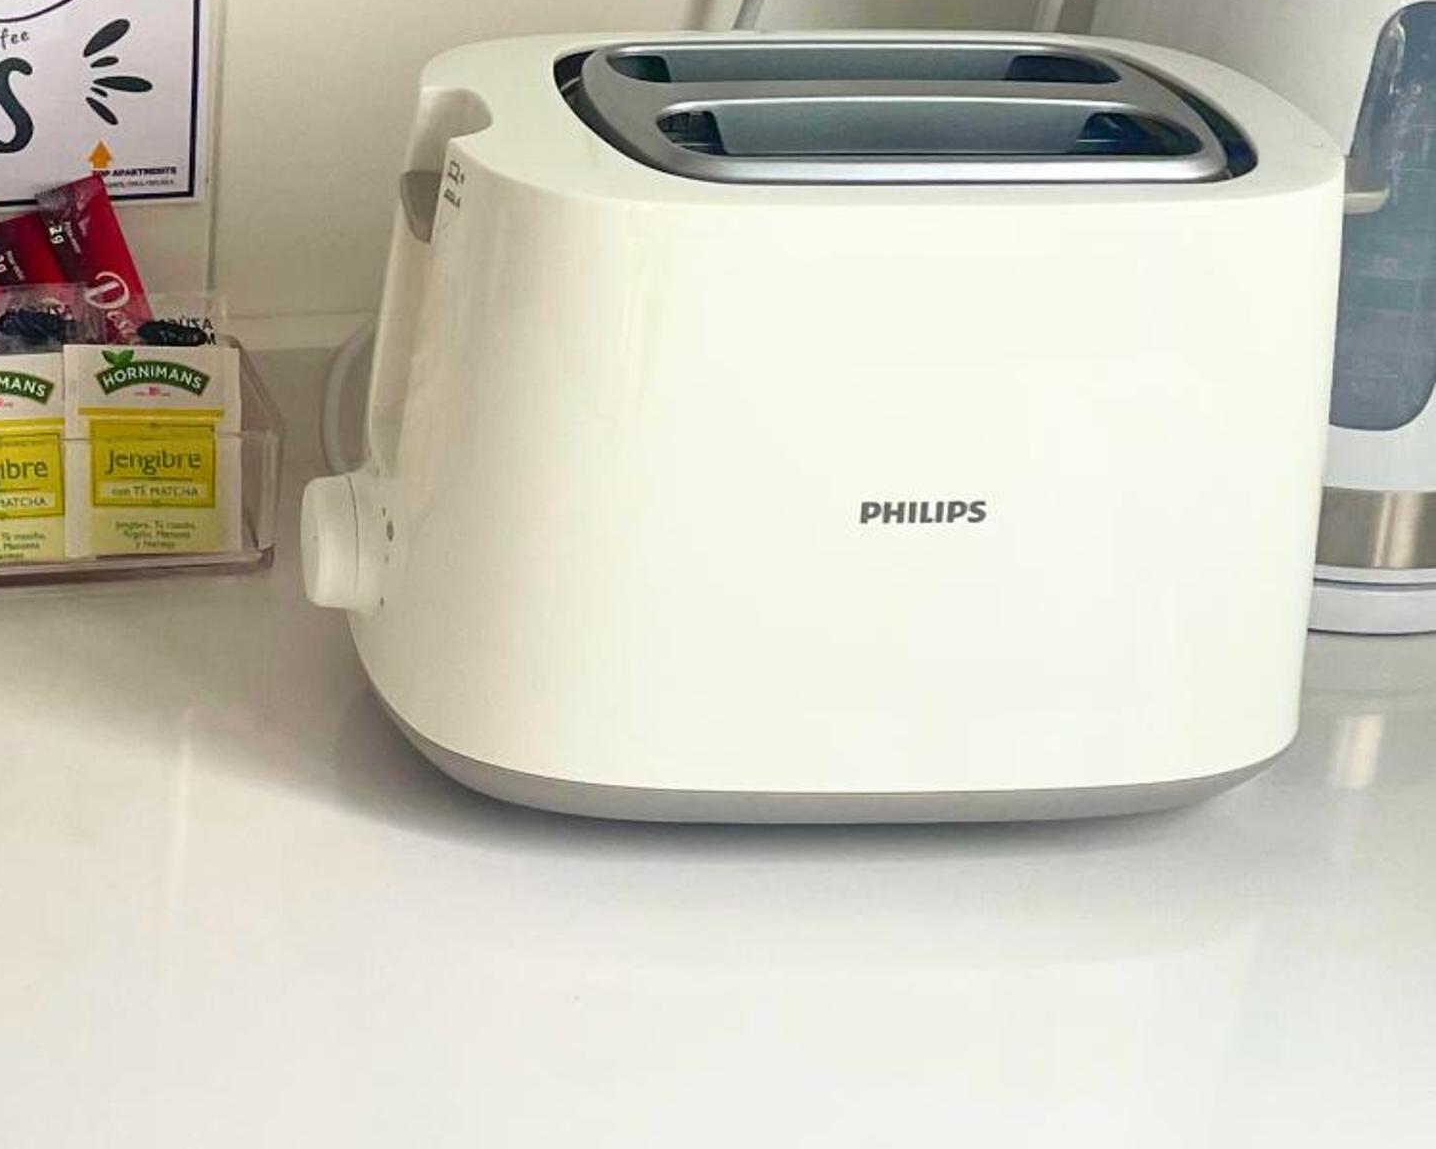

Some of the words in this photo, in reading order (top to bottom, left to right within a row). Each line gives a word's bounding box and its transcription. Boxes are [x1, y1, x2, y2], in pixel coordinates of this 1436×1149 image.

[103, 364, 203, 390] HORNIMANS
[105, 450, 202, 476] Jengibre
[860, 501, 988, 524] PHILIPS
